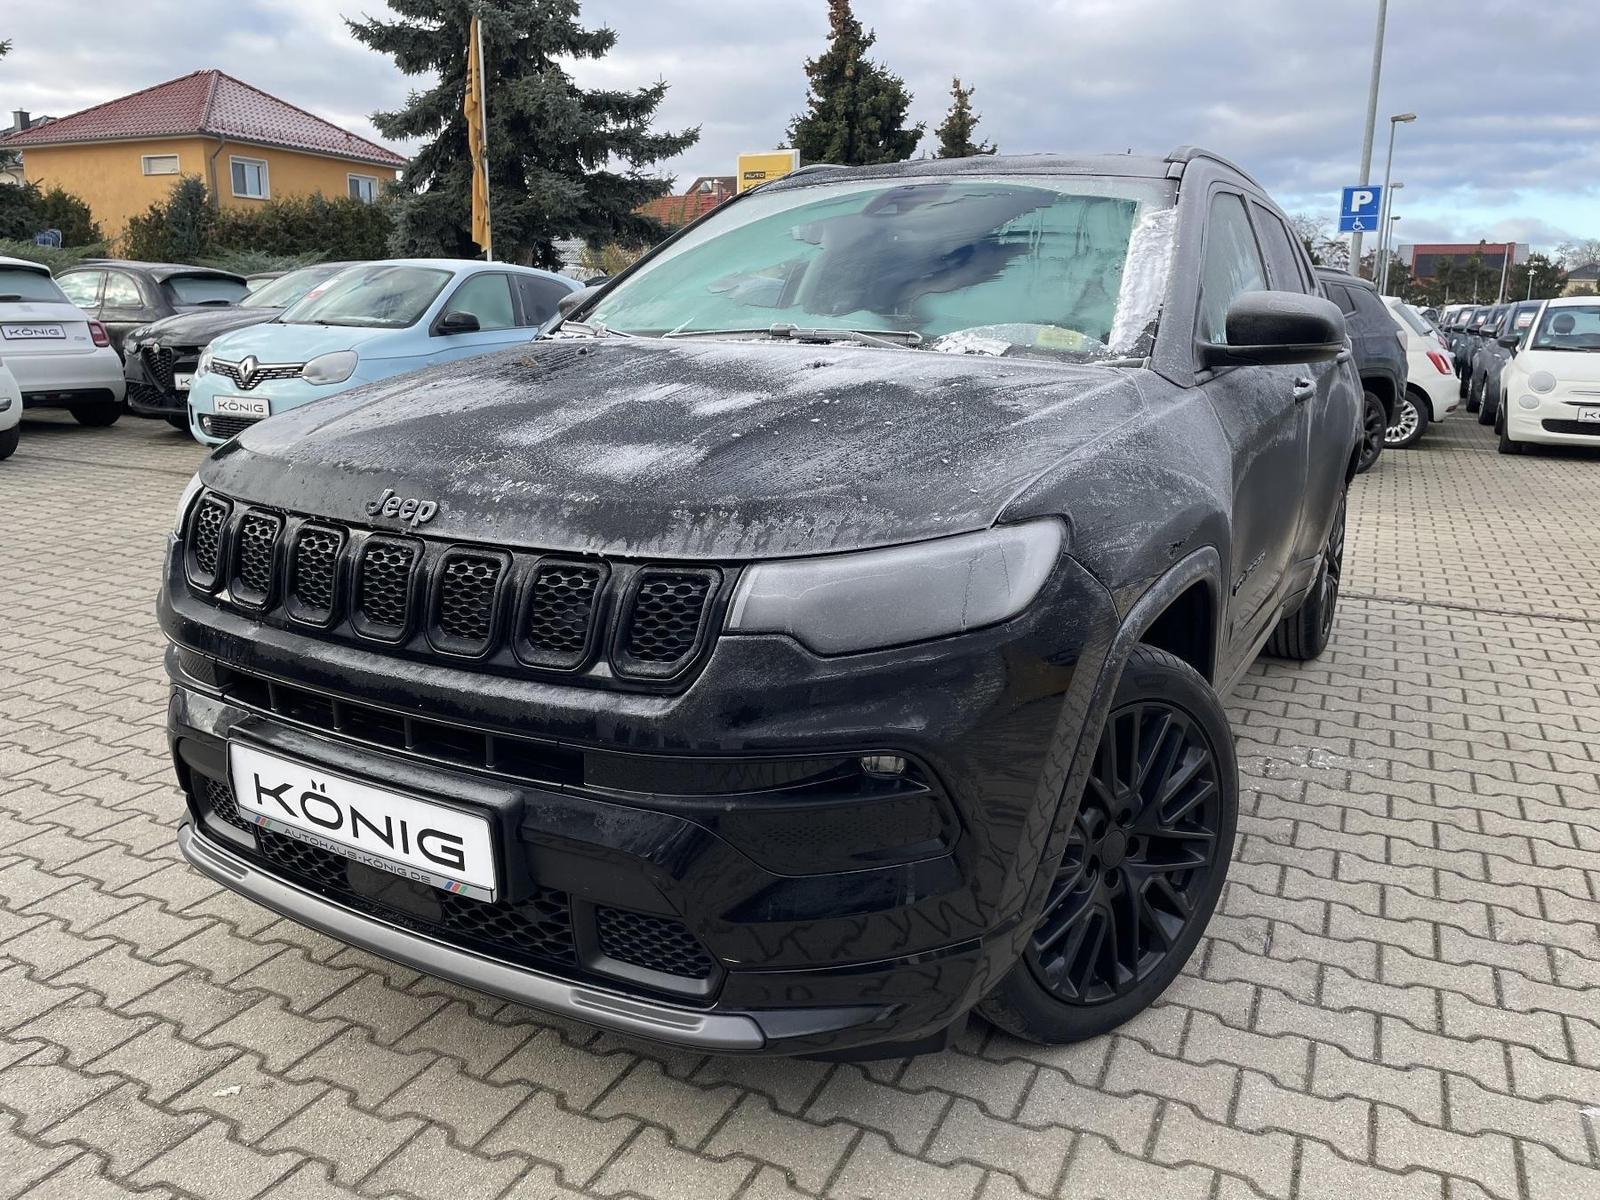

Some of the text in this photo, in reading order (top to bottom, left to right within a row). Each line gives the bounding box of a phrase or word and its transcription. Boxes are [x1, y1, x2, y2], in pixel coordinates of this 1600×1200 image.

[1351, 191, 1373, 212] P
[9, 327, 60, 336] KÖNIG
[218, 400, 264, 413] KÖNIG
[365, 488, 438, 528] Jeep
[253, 772, 466, 872] KÖNIG
